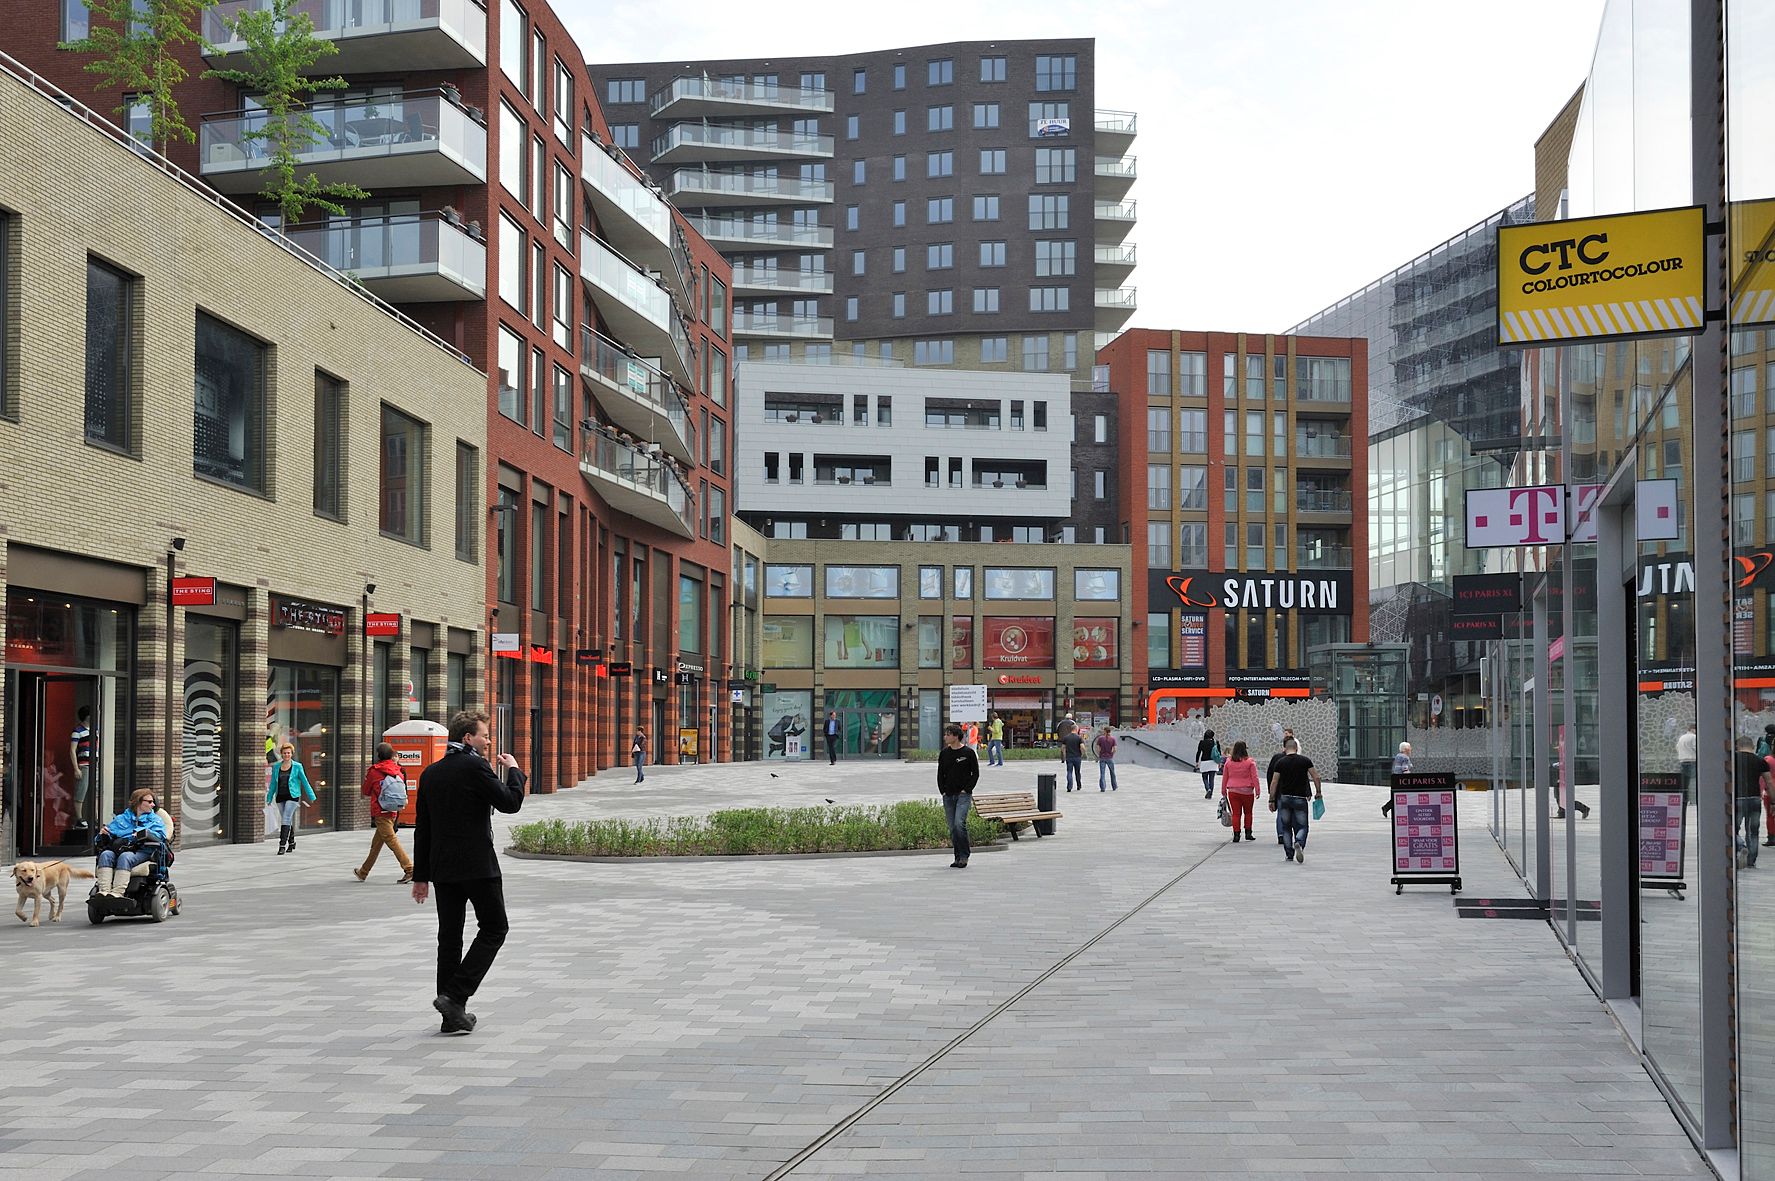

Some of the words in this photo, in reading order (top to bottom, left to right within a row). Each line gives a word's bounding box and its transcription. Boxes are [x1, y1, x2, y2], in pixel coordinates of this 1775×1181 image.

[1519, 232, 1610, 276] CTC
[1521, 257, 1684, 295] COLOURTOCOLOUR
[1510, 487, 1559, 544] T
[1223, 577, 1338, 609] SATURN
[1459, 591, 1473, 599] ICI
[1474, 589, 1501, 599] PARIS
[1502, 588, 1513, 597] XL
[1465, 621, 1486, 629] PARIS
[1000, 655, 1028, 663] Kruidvat
[1009, 675, 1041, 684] Kruidvat
[1247, 689, 1270, 697] SATURN
[1399, 778, 1411, 786] ICI
[1412, 777, 1435, 786] PARIS
